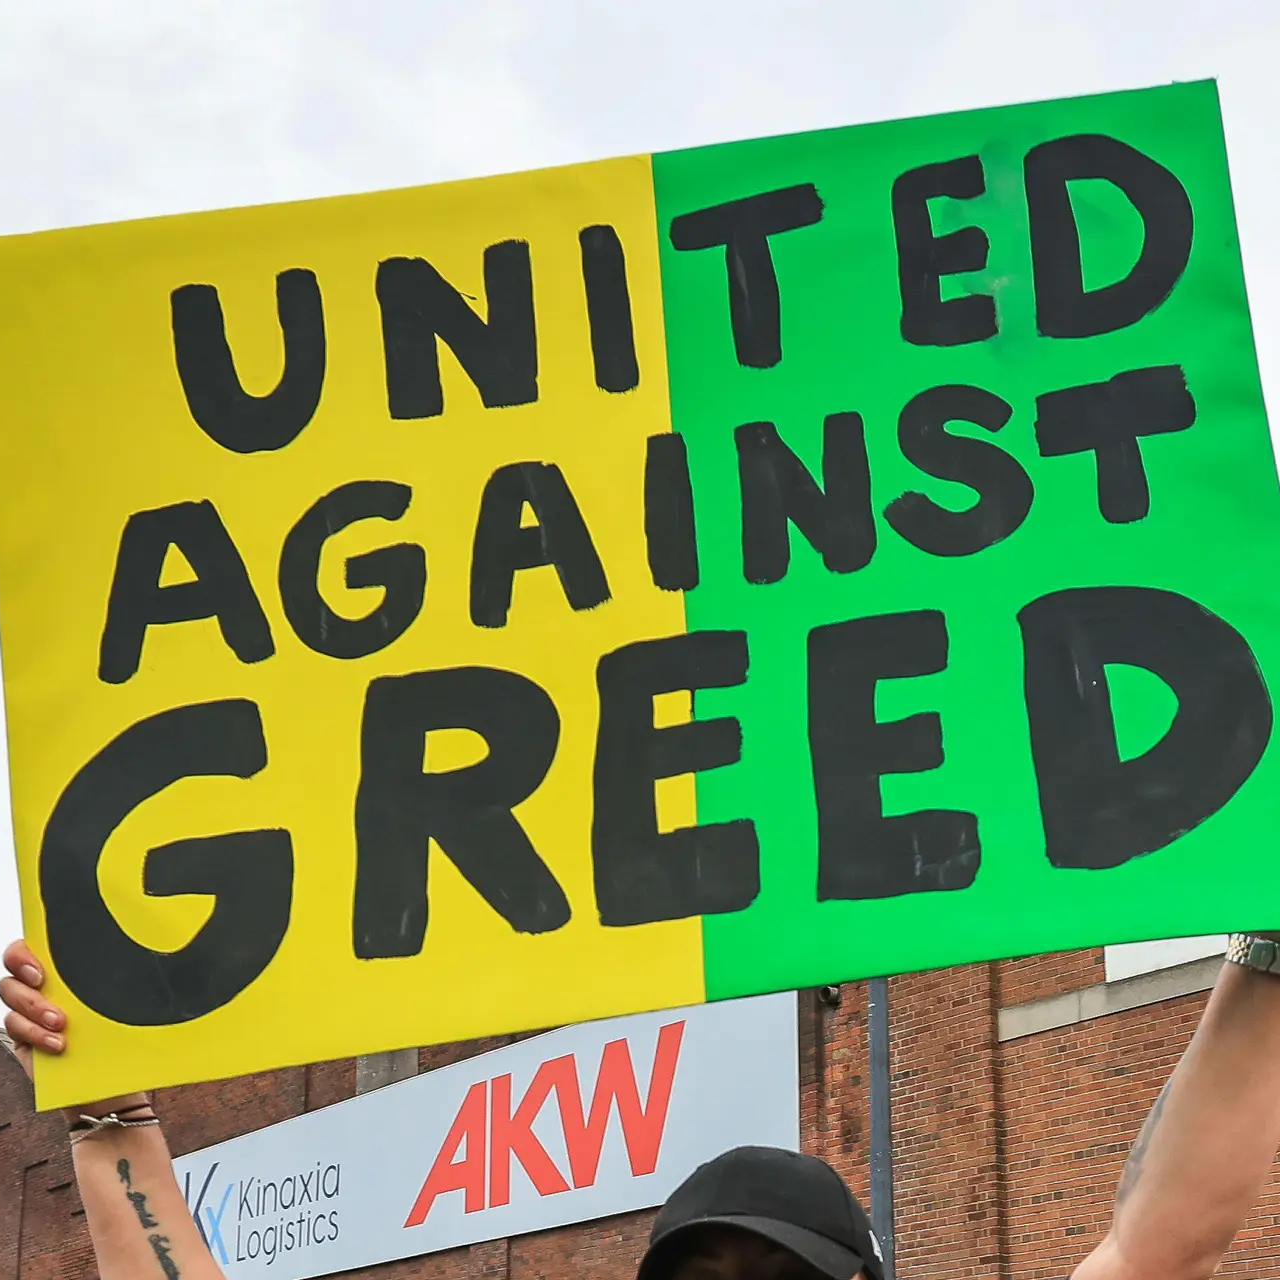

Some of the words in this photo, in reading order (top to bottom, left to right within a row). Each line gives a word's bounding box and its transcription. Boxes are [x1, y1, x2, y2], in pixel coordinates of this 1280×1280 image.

[170, 132, 1194, 454] UNITED
[97, 363, 1197, 684] AGAINST
[37, 585, 1274, 1027] GREED
[236, 1210, 340, 1266] Logistics
[237, 1160, 341, 1222] Kinaxia
[403, 1019, 687, 1229] AKW
